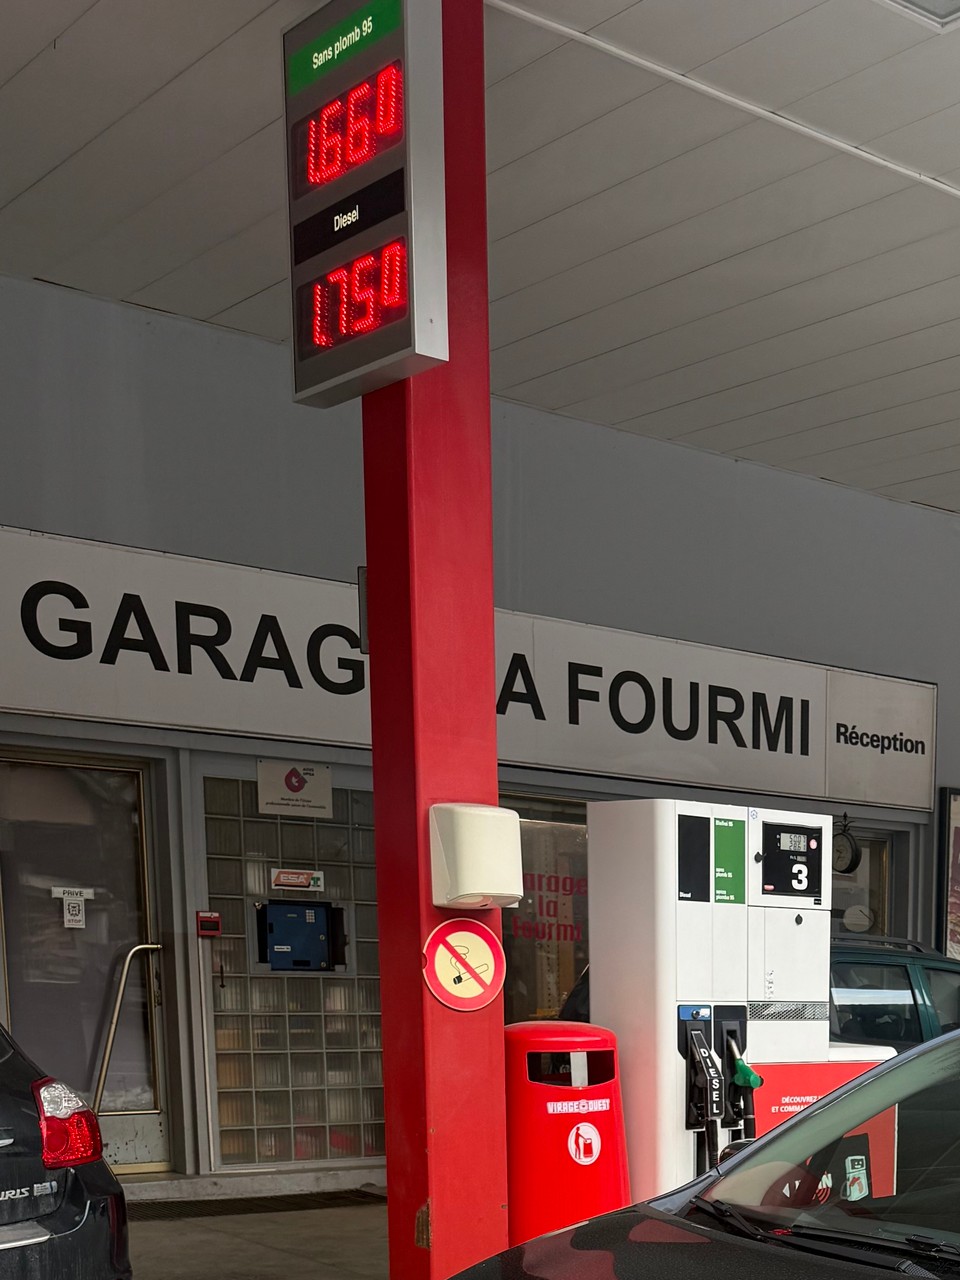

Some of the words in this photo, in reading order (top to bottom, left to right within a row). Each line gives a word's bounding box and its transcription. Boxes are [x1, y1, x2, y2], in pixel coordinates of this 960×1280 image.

[311, 44, 334, 70] Sans
[333, 26, 361, 59] plomb
[361, 16, 374, 38] 95
[333, 205, 360, 233] Diesel
[20, 580, 367, 696] GARAG
[496, 653, 546, 721] A
[567, 661, 811, 757] FOURMI
[836, 722, 927, 756] Réception
[280, 874, 305, 884] ESA
[524, 872, 588, 897] arage
[791, 864, 809, 891] 3
[62, 889, 85, 897] PRIVE
[538, 895, 558, 918] la
[699, 1048, 720, 1114] DIESEL
[547, 1101, 579, 1115] VIRAGE
[588, 1098, 610, 1112] OUEST
[782, 1095, 817, 1104] DÉCOUVREZ
[0, 1187, 30, 1201] URIS
